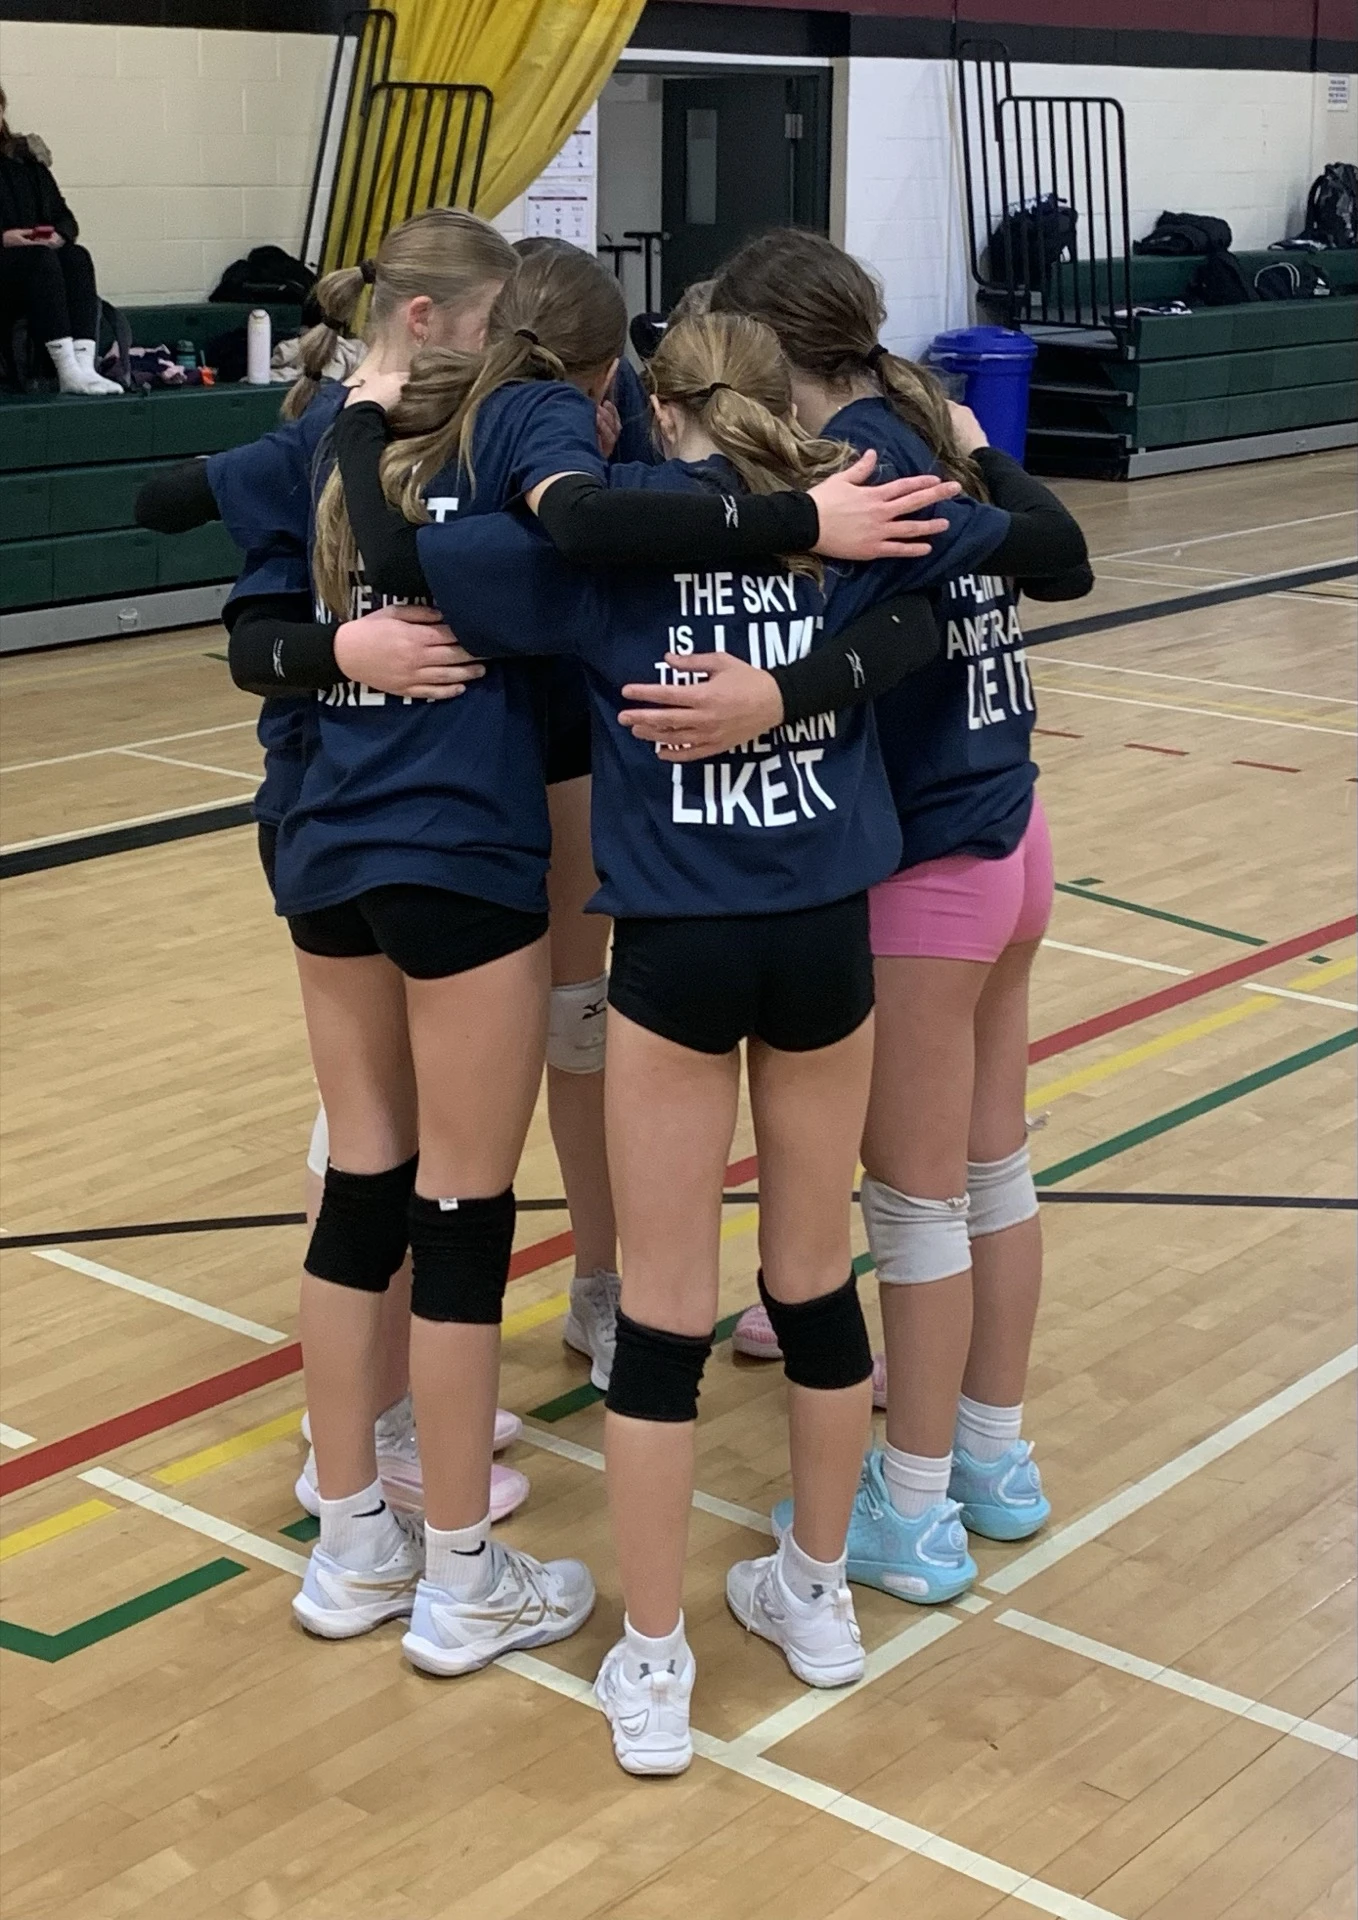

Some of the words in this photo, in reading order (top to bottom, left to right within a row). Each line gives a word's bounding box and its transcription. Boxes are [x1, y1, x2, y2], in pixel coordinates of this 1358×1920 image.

[674, 572, 735, 616] THE
[741, 573, 797, 614] SKY
[668, 625, 694, 655] IS
[671, 754, 797, 828] LIKE
[788, 747, 837, 819] IT
